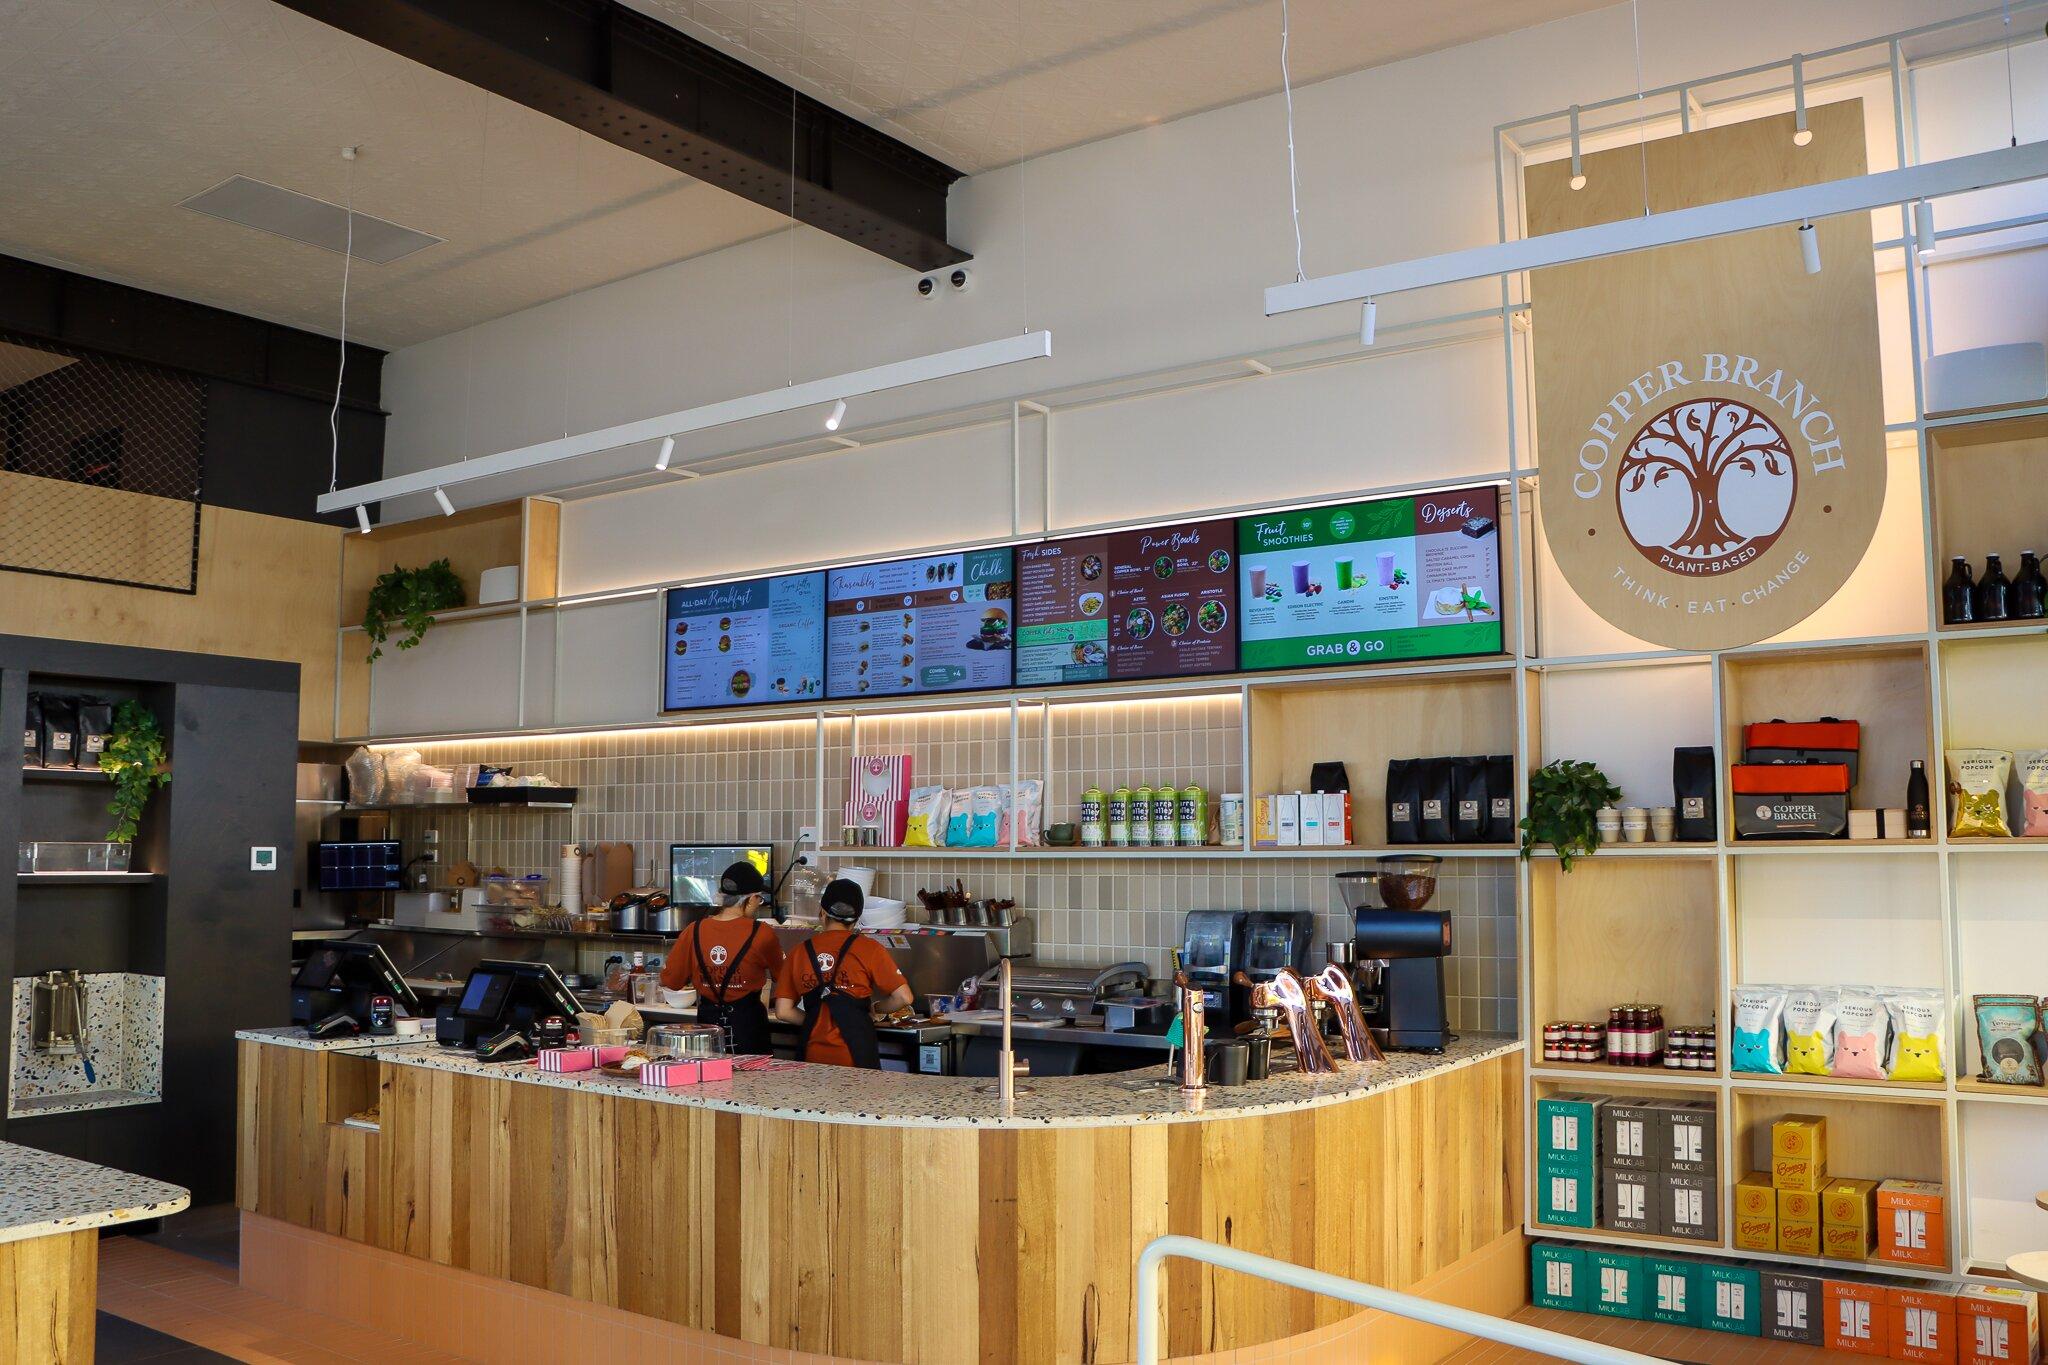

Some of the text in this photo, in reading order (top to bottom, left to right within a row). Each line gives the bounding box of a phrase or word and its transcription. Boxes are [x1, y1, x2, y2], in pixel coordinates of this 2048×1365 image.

[1573, 353, 1847, 499] COPPER BRANCH
[1421, 500, 1474, 524] Desserts
[1254, 520, 1287, 541] Fruit
[1141, 529, 1200, 554] Power Bowls
[1263, 533, 1314, 547] SMOOTHIES
[1041, 547, 1062, 557] SIDES
[1660, 547, 1757, 573] PLANT-BASED
[1611, 551, 1810, 614] THINK EAT CHANGE
[708, 585, 752, 609] Breakfast
[1306, 643, 1344, 656] GRAB
[1364, 640, 1385, 652] GO
[1081, 808, 1100, 816] alley
[1154, 807, 1173, 815] alley
[1773, 805, 1815, 813] COPPER
[1773, 812, 1817, 820] BRANCH
[1901, 1009, 1933, 1018] POPCORN
[1548, 1105, 1579, 1113] MILKLAB
[1612, 1109, 1644, 1118] MILKLAB
[1671, 1114, 1704, 1123] MILKLAB
[1547, 1152, 1578, 1161] MILKLAB
[1613, 1157, 1645, 1166] MILKLAB
[1548, 1166, 1579, 1175] MILKLAB
[1671, 1162, 1704, 1172] MILKLAB
[1615, 1172, 1647, 1182] MILKLAB
[1670, 1177, 1703, 1187] MILKLAB
[1547, 1214, 1578, 1223] MILKLAB
[1614, 1220, 1647, 1230] MILKLAB
[1671, 1225, 1705, 1236] MILKLAB
